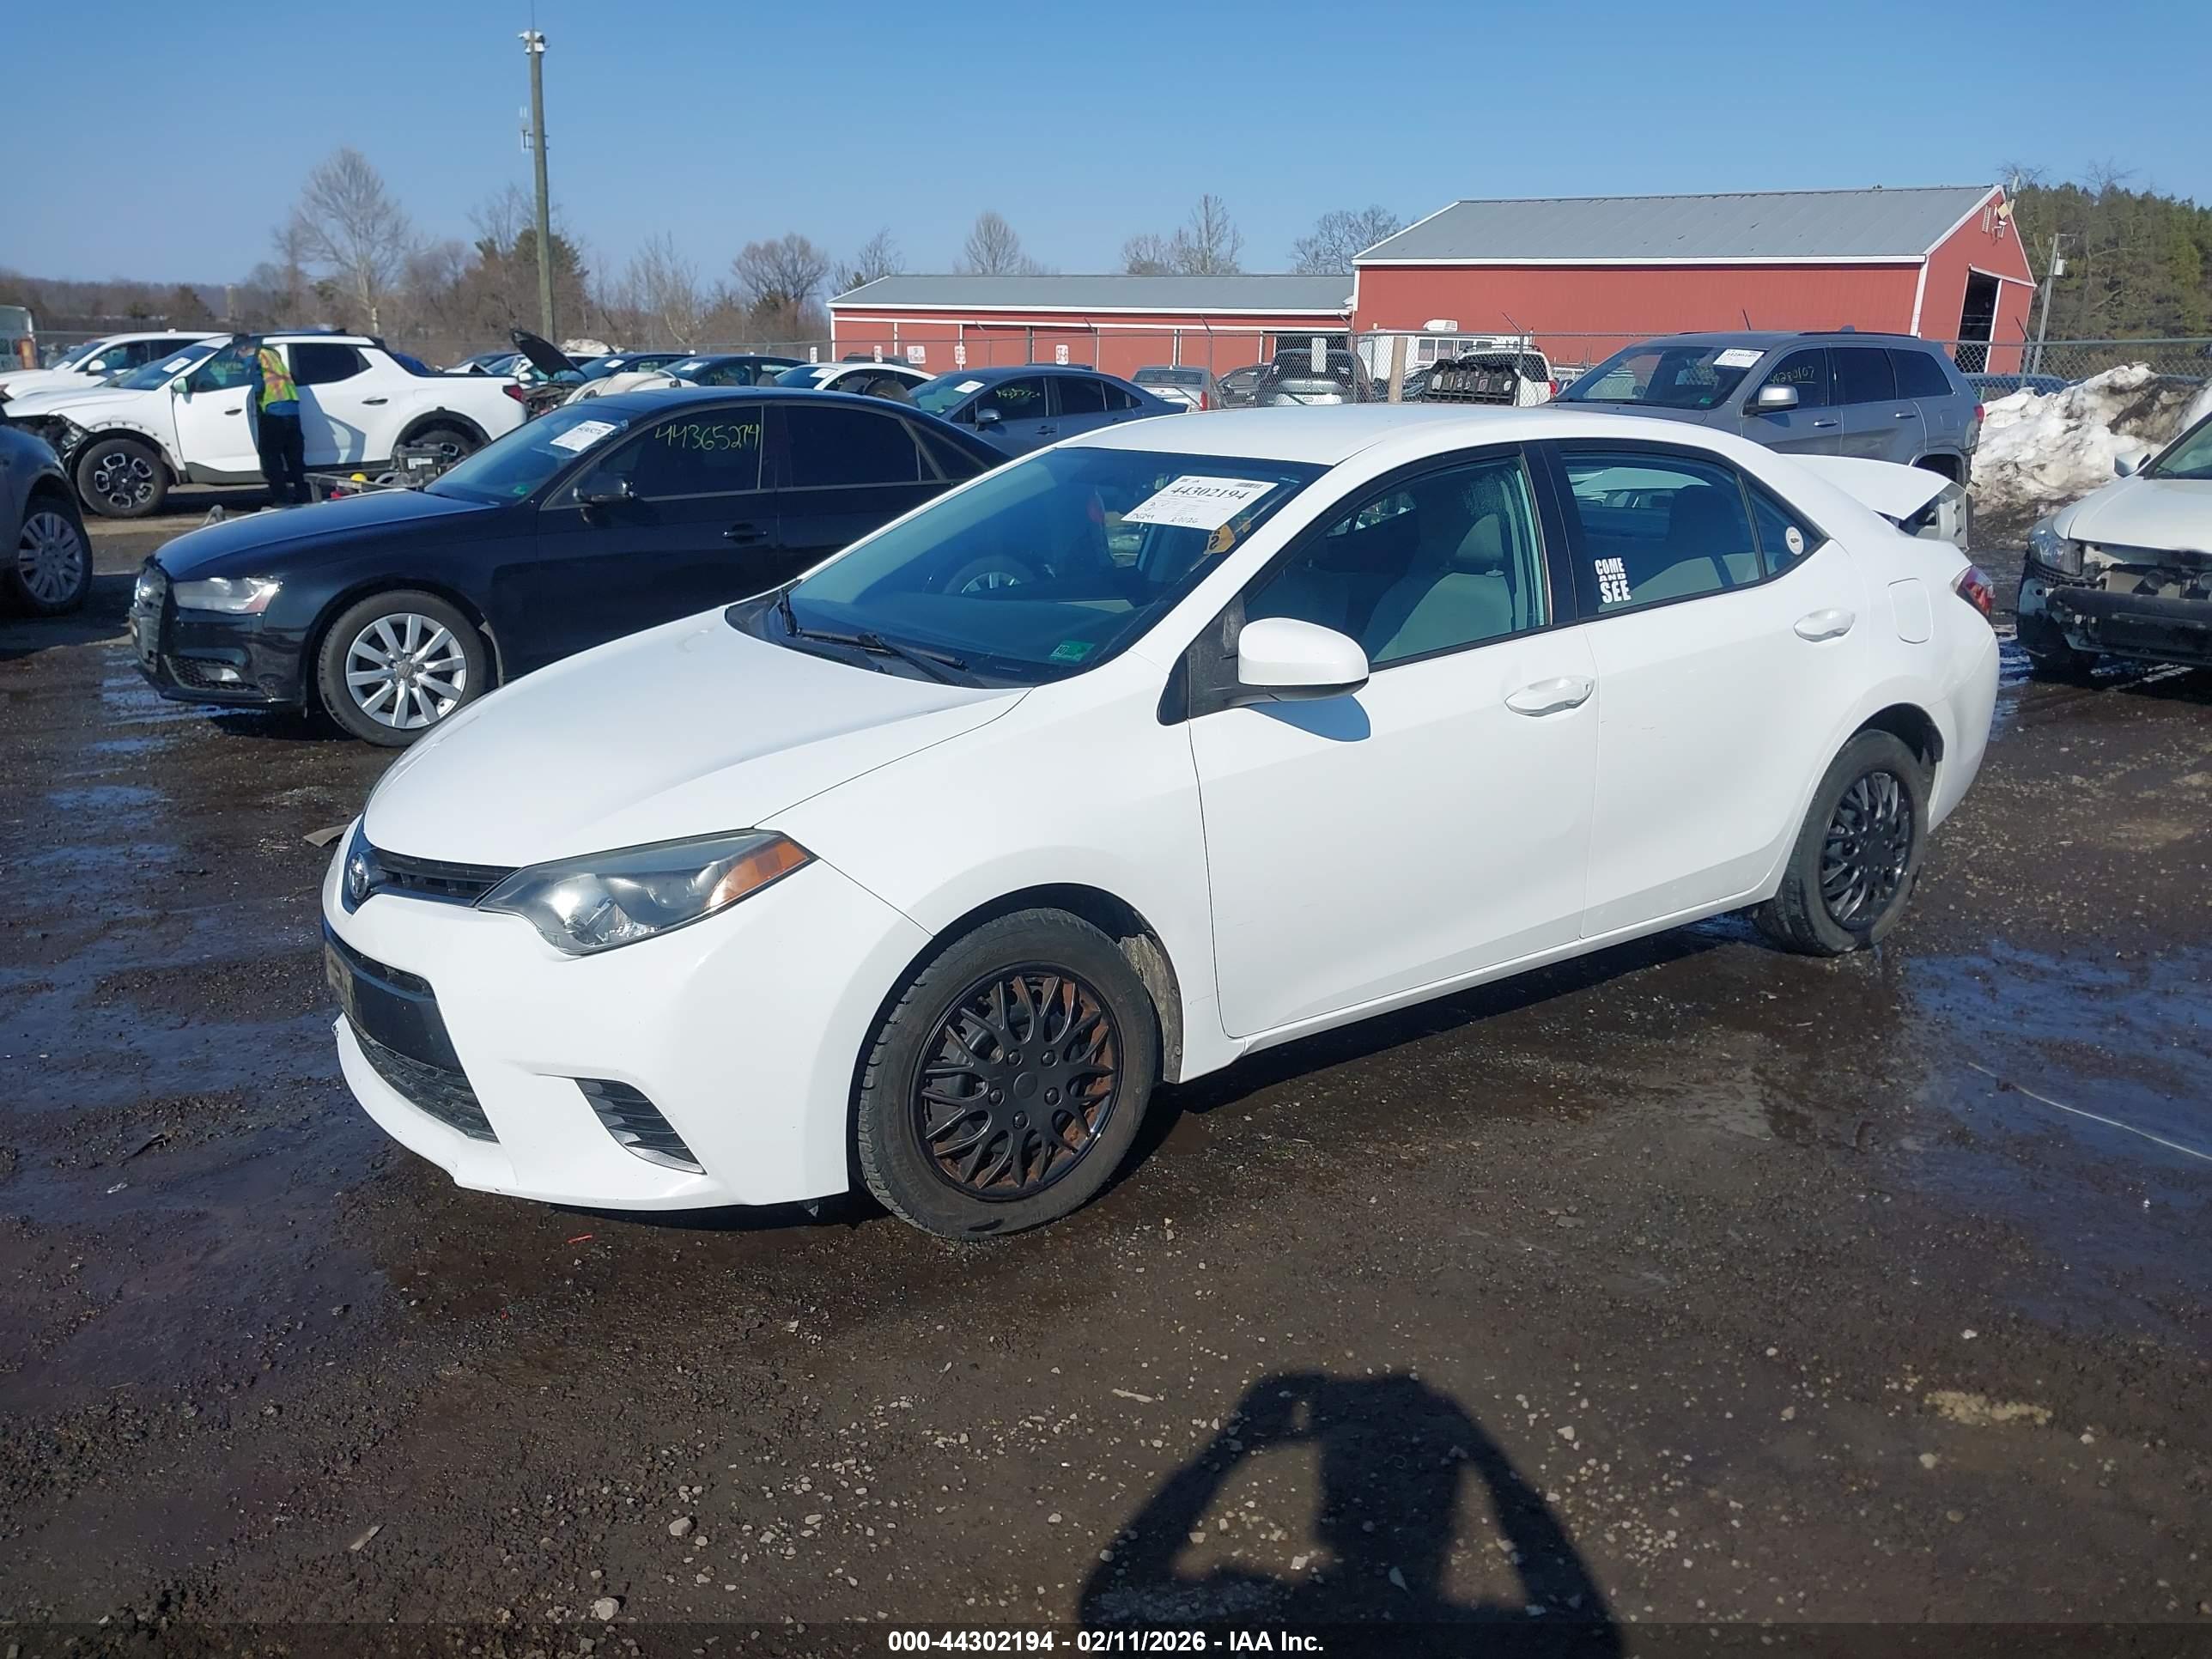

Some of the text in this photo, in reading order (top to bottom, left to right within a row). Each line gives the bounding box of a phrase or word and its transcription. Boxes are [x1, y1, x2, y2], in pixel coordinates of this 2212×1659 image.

[1170, 486, 1250, 500] 44302194
[1595, 557, 1625, 575] COME
[1599, 573, 1626, 582] AND
[1600, 580, 1632, 603] SEE
